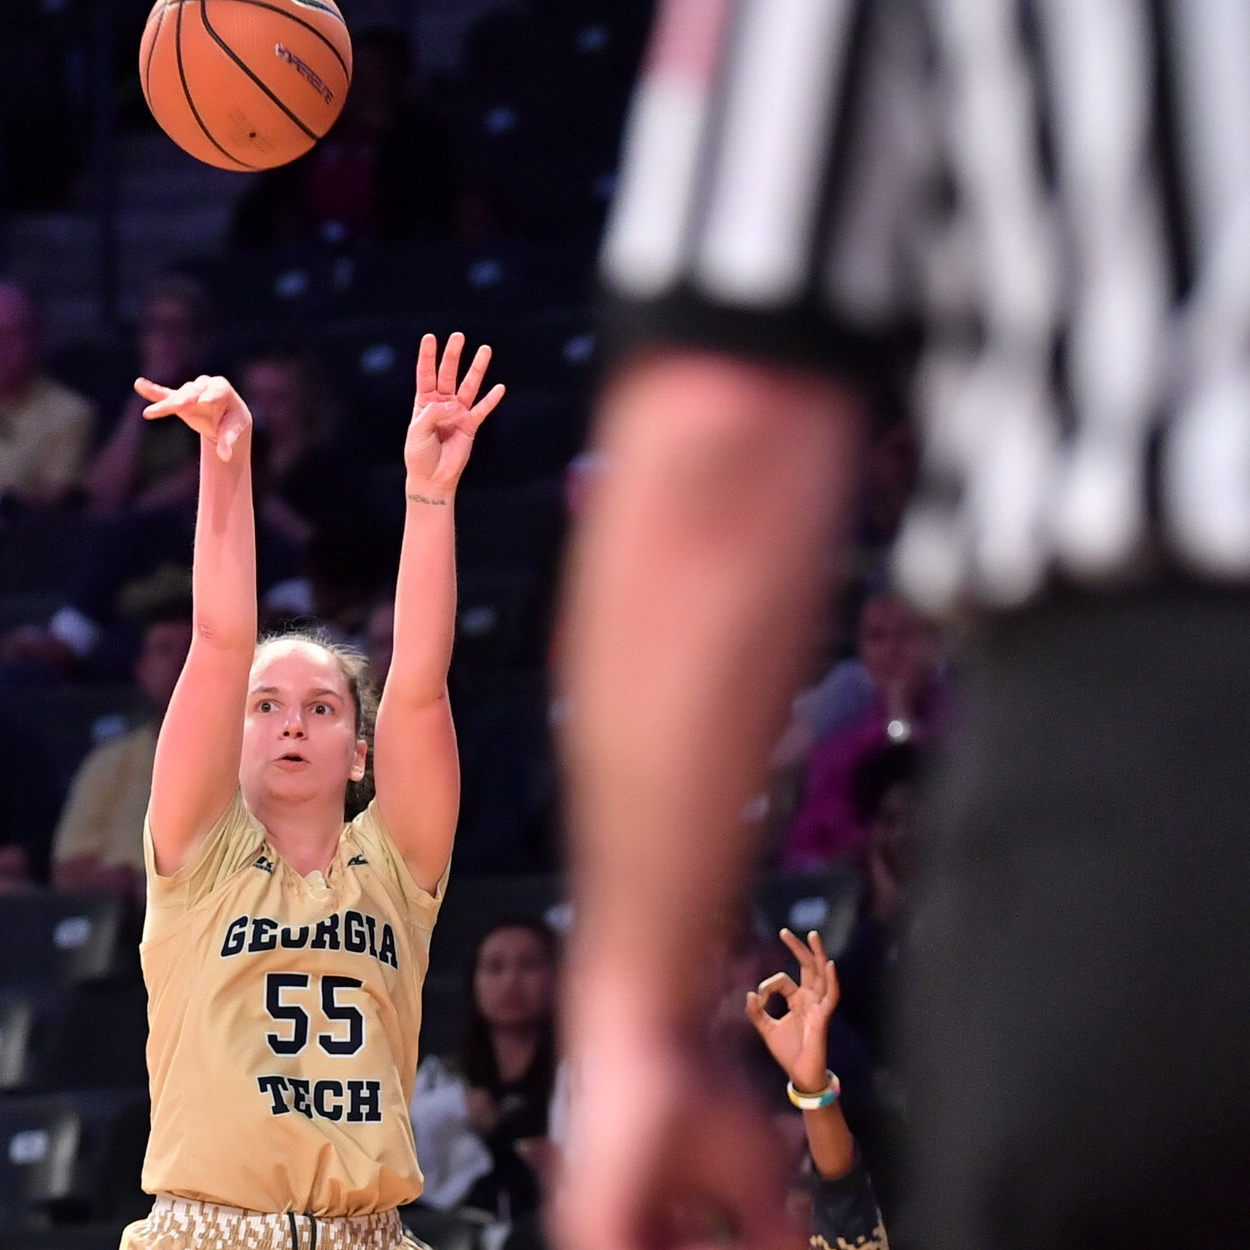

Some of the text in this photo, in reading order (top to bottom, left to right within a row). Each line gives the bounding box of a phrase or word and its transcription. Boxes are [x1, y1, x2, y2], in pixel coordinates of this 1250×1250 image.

[220, 910, 399, 970] GEORGIA
[263, 971, 366, 1058] 55
[257, 1075, 382, 1122] TECH
